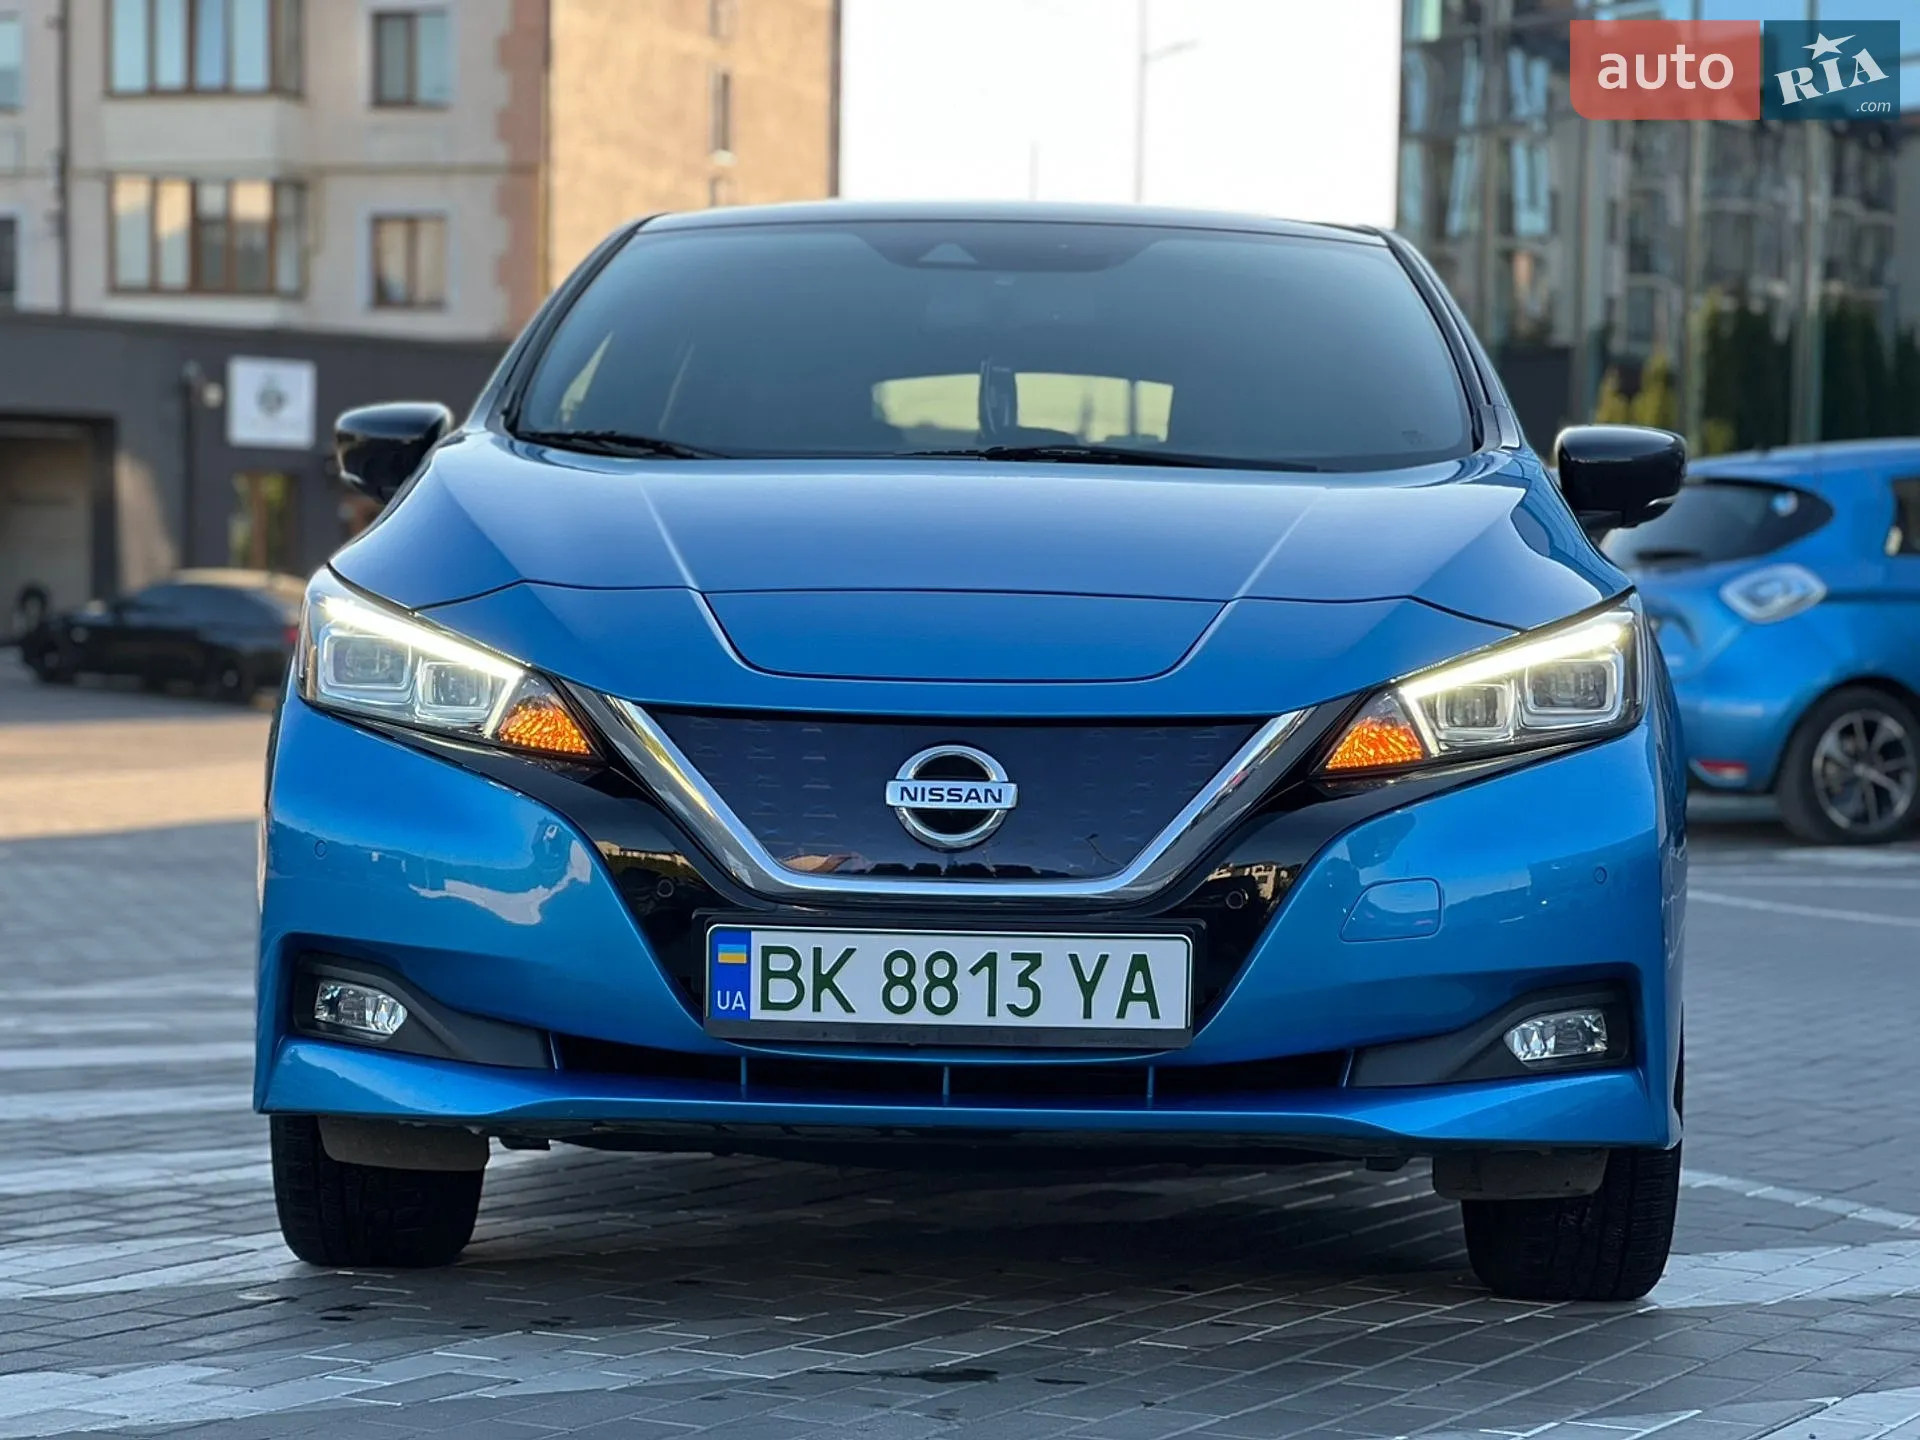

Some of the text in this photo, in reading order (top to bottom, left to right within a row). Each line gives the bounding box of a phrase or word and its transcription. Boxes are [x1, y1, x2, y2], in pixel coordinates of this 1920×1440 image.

[900, 786, 1003, 804] NISSAN
[760, 945, 1161, 1020] BK 8813 YA
[716, 990, 746, 1011] UA
